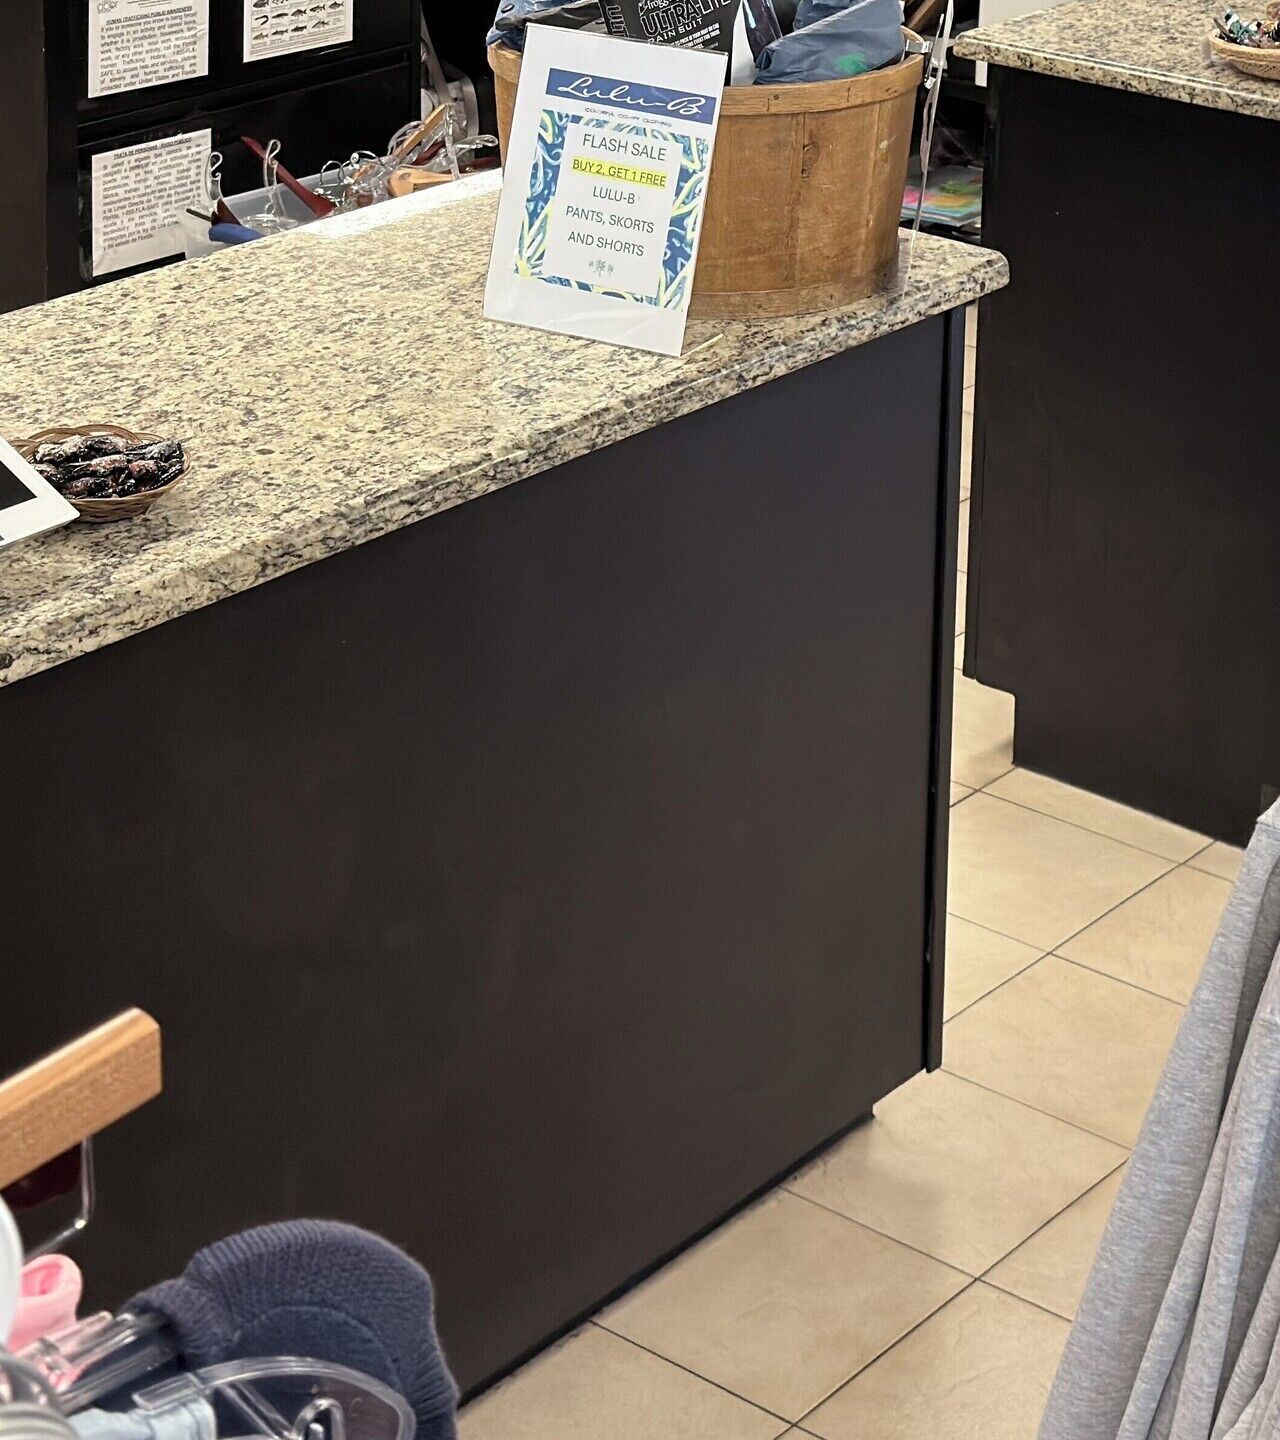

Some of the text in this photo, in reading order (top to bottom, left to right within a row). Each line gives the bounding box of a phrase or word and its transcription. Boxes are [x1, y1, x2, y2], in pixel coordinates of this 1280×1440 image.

[678, 17, 703, 34] SUIT
[557, 76, 708, 116] Lulu-B
[581, 133, 668, 162] FLASH SALE
[572, 158, 595, 173] BUY
[608, 165, 631, 180] GET
[631, 169, 638, 182] 1
[639, 170, 668, 187] FREE
[592, 186, 637, 205] LULU-B
[566, 205, 656, 234] PANTS, SKORTS
[567, 231, 646, 257] AND SHORTS
